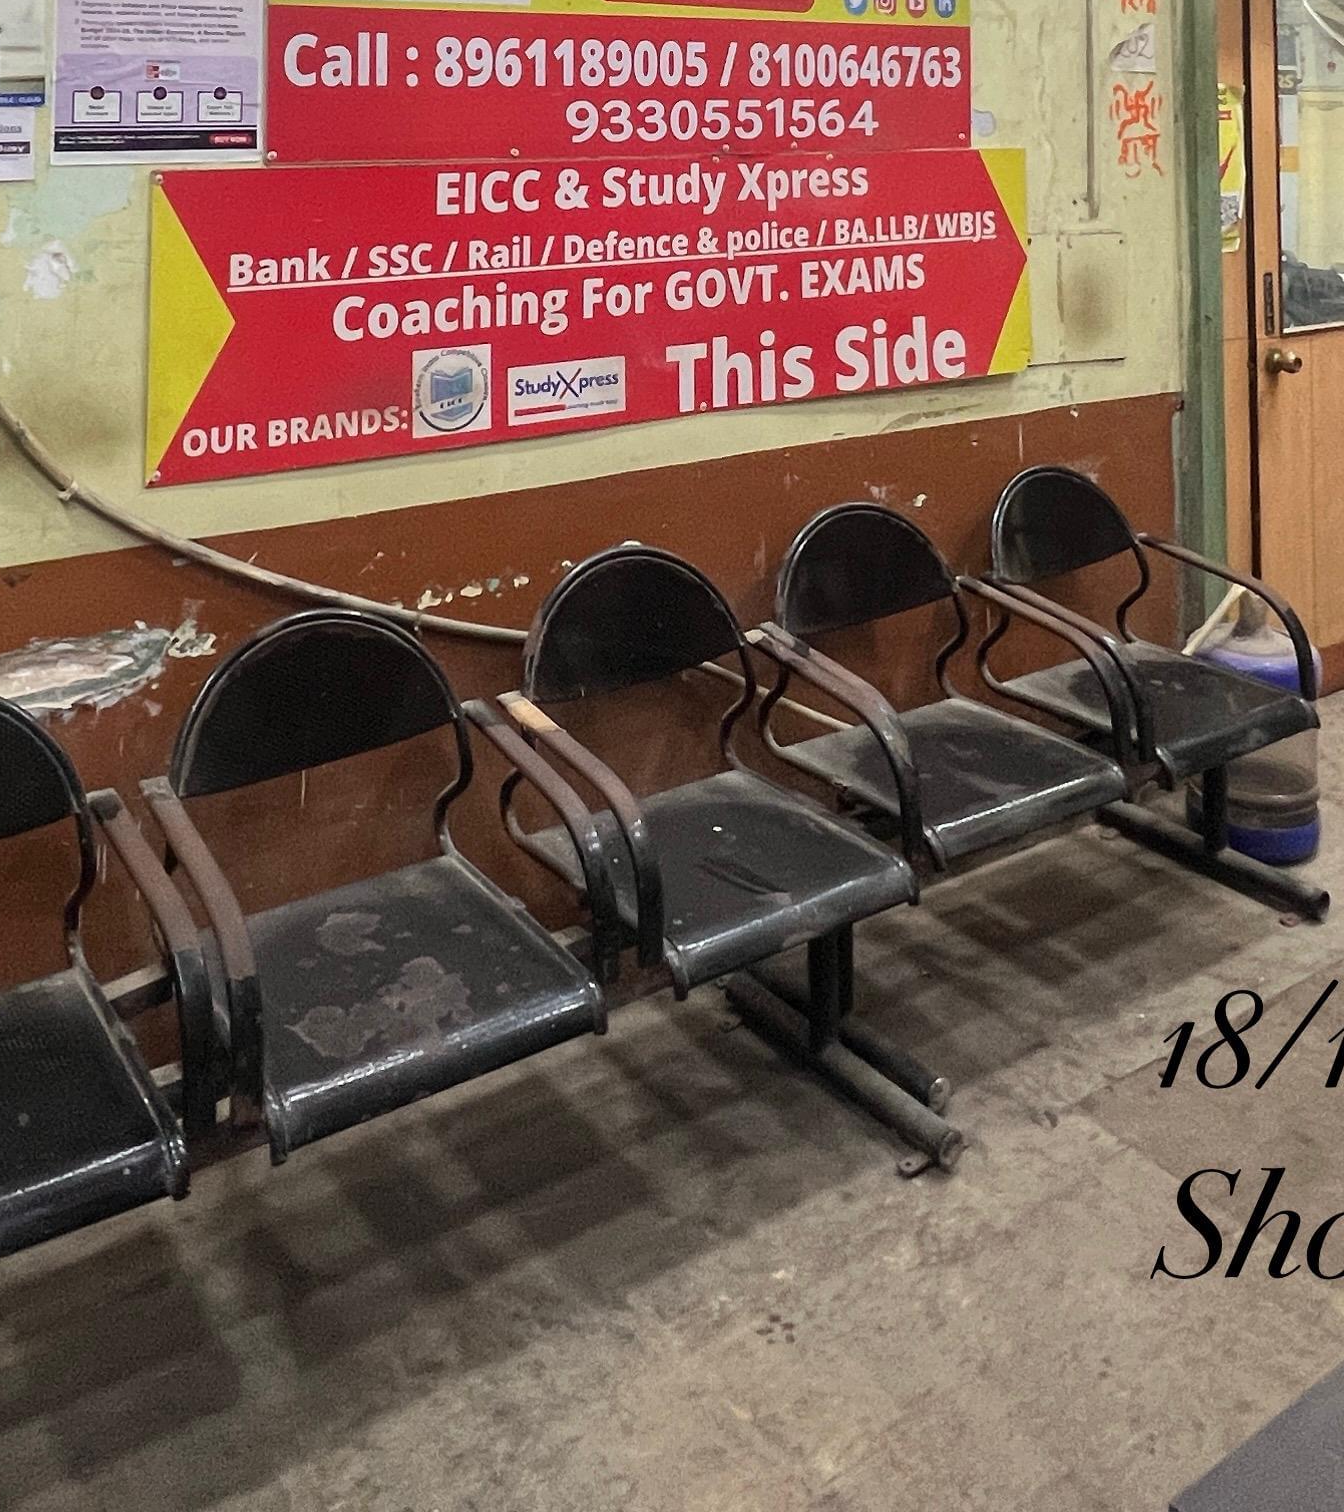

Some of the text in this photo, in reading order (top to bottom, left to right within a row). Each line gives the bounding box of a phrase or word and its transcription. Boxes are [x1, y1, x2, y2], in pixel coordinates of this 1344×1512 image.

[283, 32, 389, 88] Call
[434, 36, 709, 88] 8961189005
[748, 43, 962, 89] 8100646763
[565, 98, 879, 144] 9330551564
[435, 162, 869, 216] EICC & Study Xpress
[229, 247, 332, 286] Bank
[368, 243, 433, 277] SSC
[468, 235, 531, 271] Rail
[564, 230, 689, 264] Defence
[697, 227, 719, 254] &
[727, 221, 809, 260] police
[935, 210, 997, 243] WBJS
[332, 253, 925, 341] Coaching For GOVT. EXAMS
[665, 315, 966, 413] This Side
[182, 405, 409, 458] OUR BRANDS:
